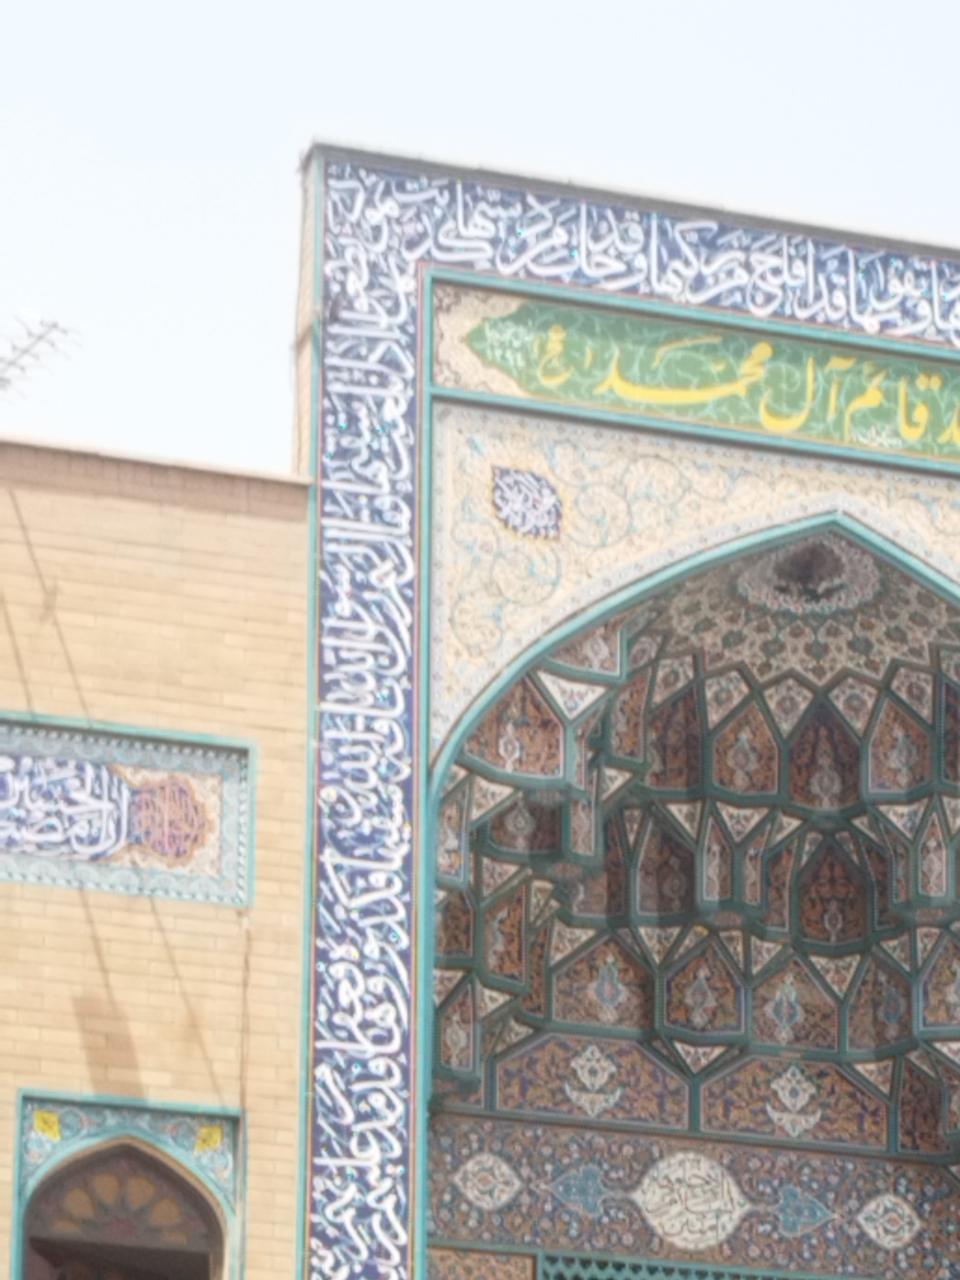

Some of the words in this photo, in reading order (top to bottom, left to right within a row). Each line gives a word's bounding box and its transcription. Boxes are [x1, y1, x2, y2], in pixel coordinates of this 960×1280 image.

[593, 336, 773, 405] محمد
[761, 356, 855, 433] آل
[844, 358, 943, 443] قائم
